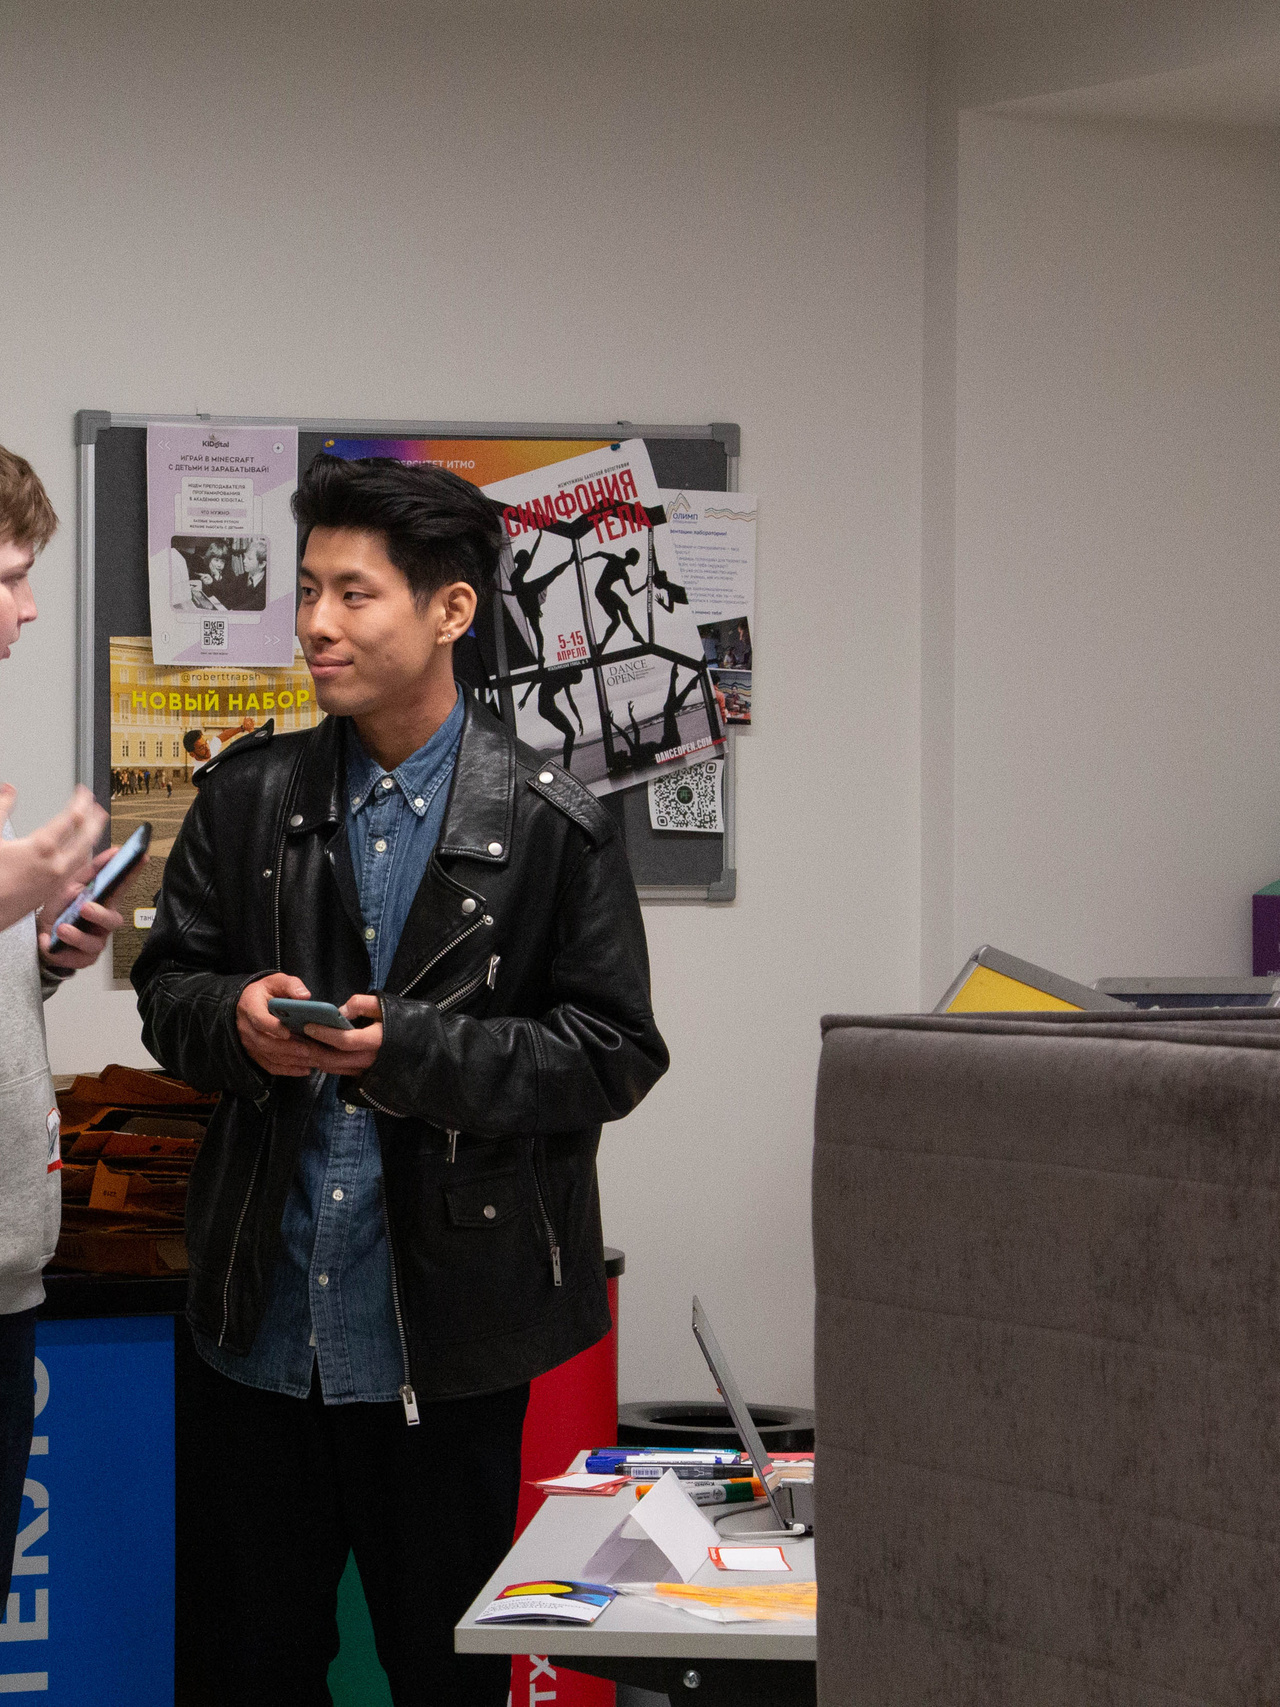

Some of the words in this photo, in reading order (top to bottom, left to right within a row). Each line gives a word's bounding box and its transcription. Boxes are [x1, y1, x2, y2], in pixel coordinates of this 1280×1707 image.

[180, 454, 203, 462] ИГРАЙ
[446, 460, 475, 469] ИТМО
[175, 464, 203, 472] ДЕТЬМИ
[211, 465, 270, 473] ЗАРАБАТЫВАЙ!
[502, 469, 638, 537] СИМФОНИЯ
[588, 501, 653, 544] ТЕЛА
[672, 512, 698, 520] ОЛИМП
[557, 631, 584, 649] 5-15
[557, 647, 587, 662] АПРЕЛЯ
[608, 659, 647, 676] DANCE
[181, 672, 261, 683] @roberttrapsh
[607, 672, 637, 687] OPEN
[131, 689, 220, 711] НОВЫЙ
[228, 689, 310, 711] НАБОР
[655, 736, 713, 763] DANCEOPEN.COM
